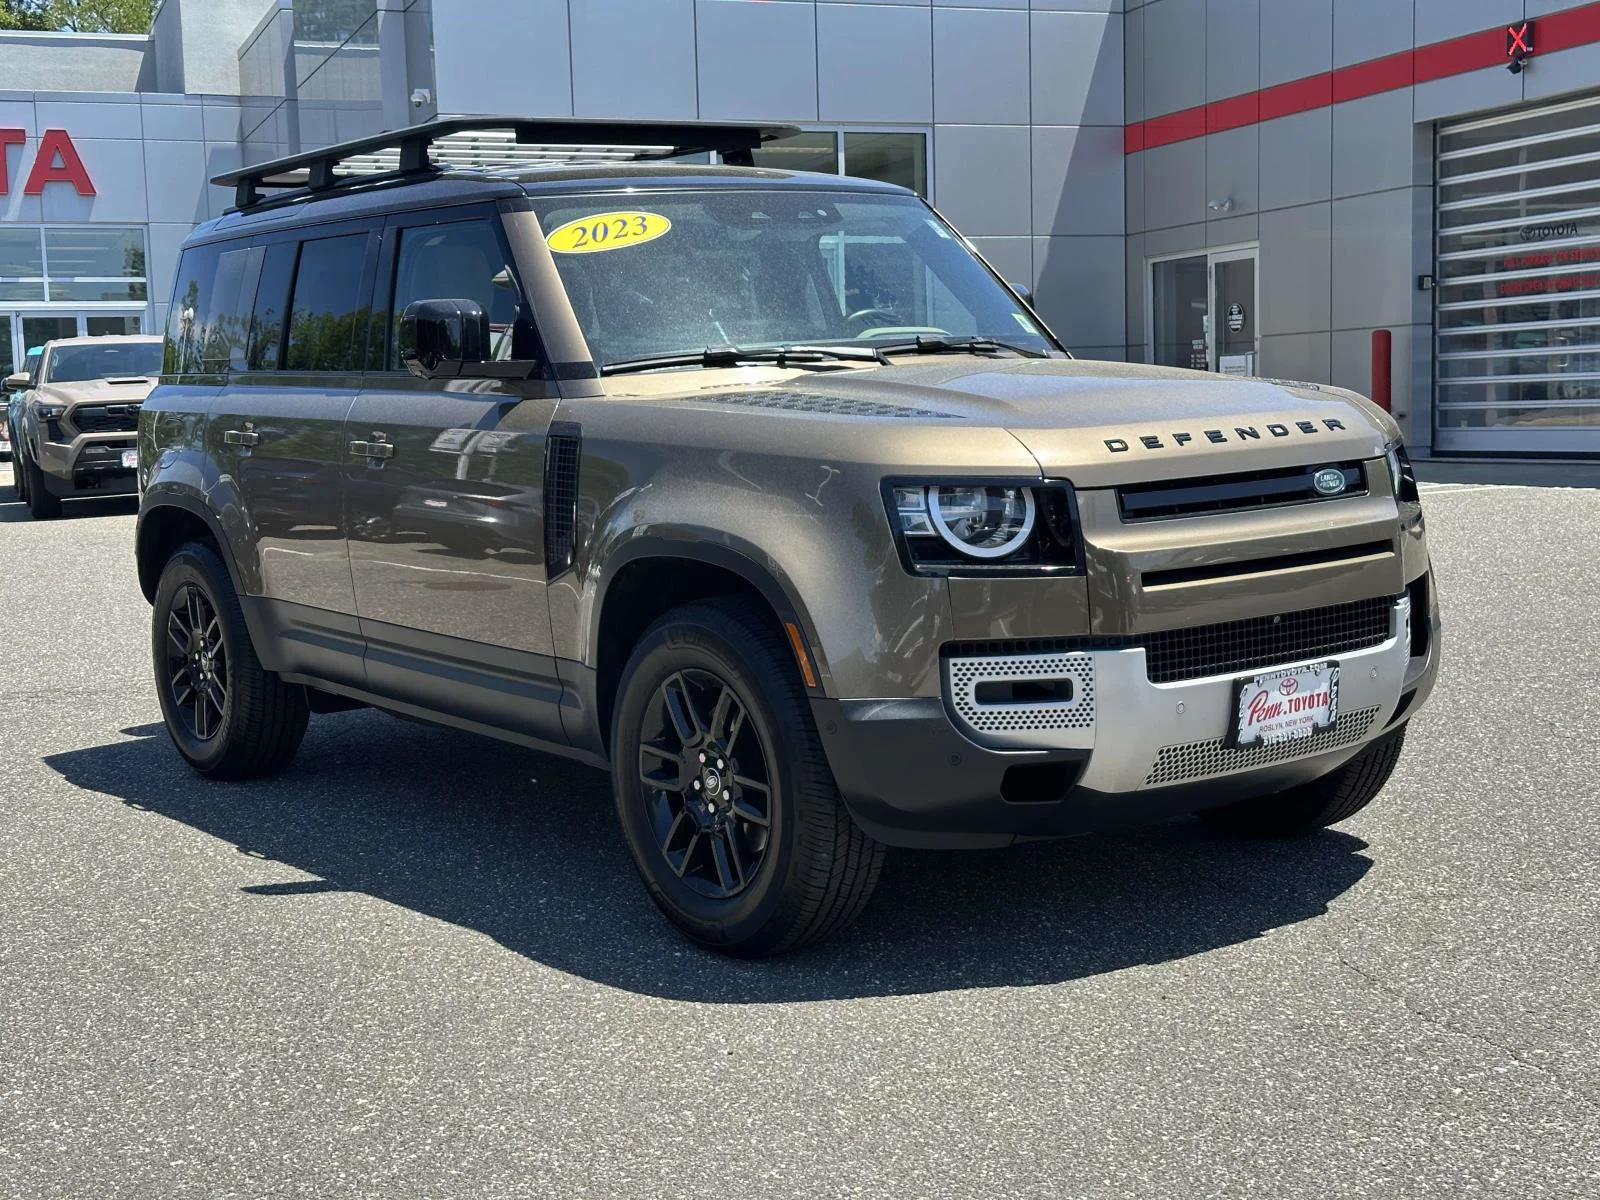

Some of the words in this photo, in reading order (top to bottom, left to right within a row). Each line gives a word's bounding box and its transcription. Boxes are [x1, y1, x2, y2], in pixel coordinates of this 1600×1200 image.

[572, 216, 648, 249] 2023
[1535, 222, 1578, 238] TOYOTA
[1103, 418, 1346, 453] DEFENDER
[1285, 719, 1298, 729] NEW
[1299, 715, 1314, 726] YORK
